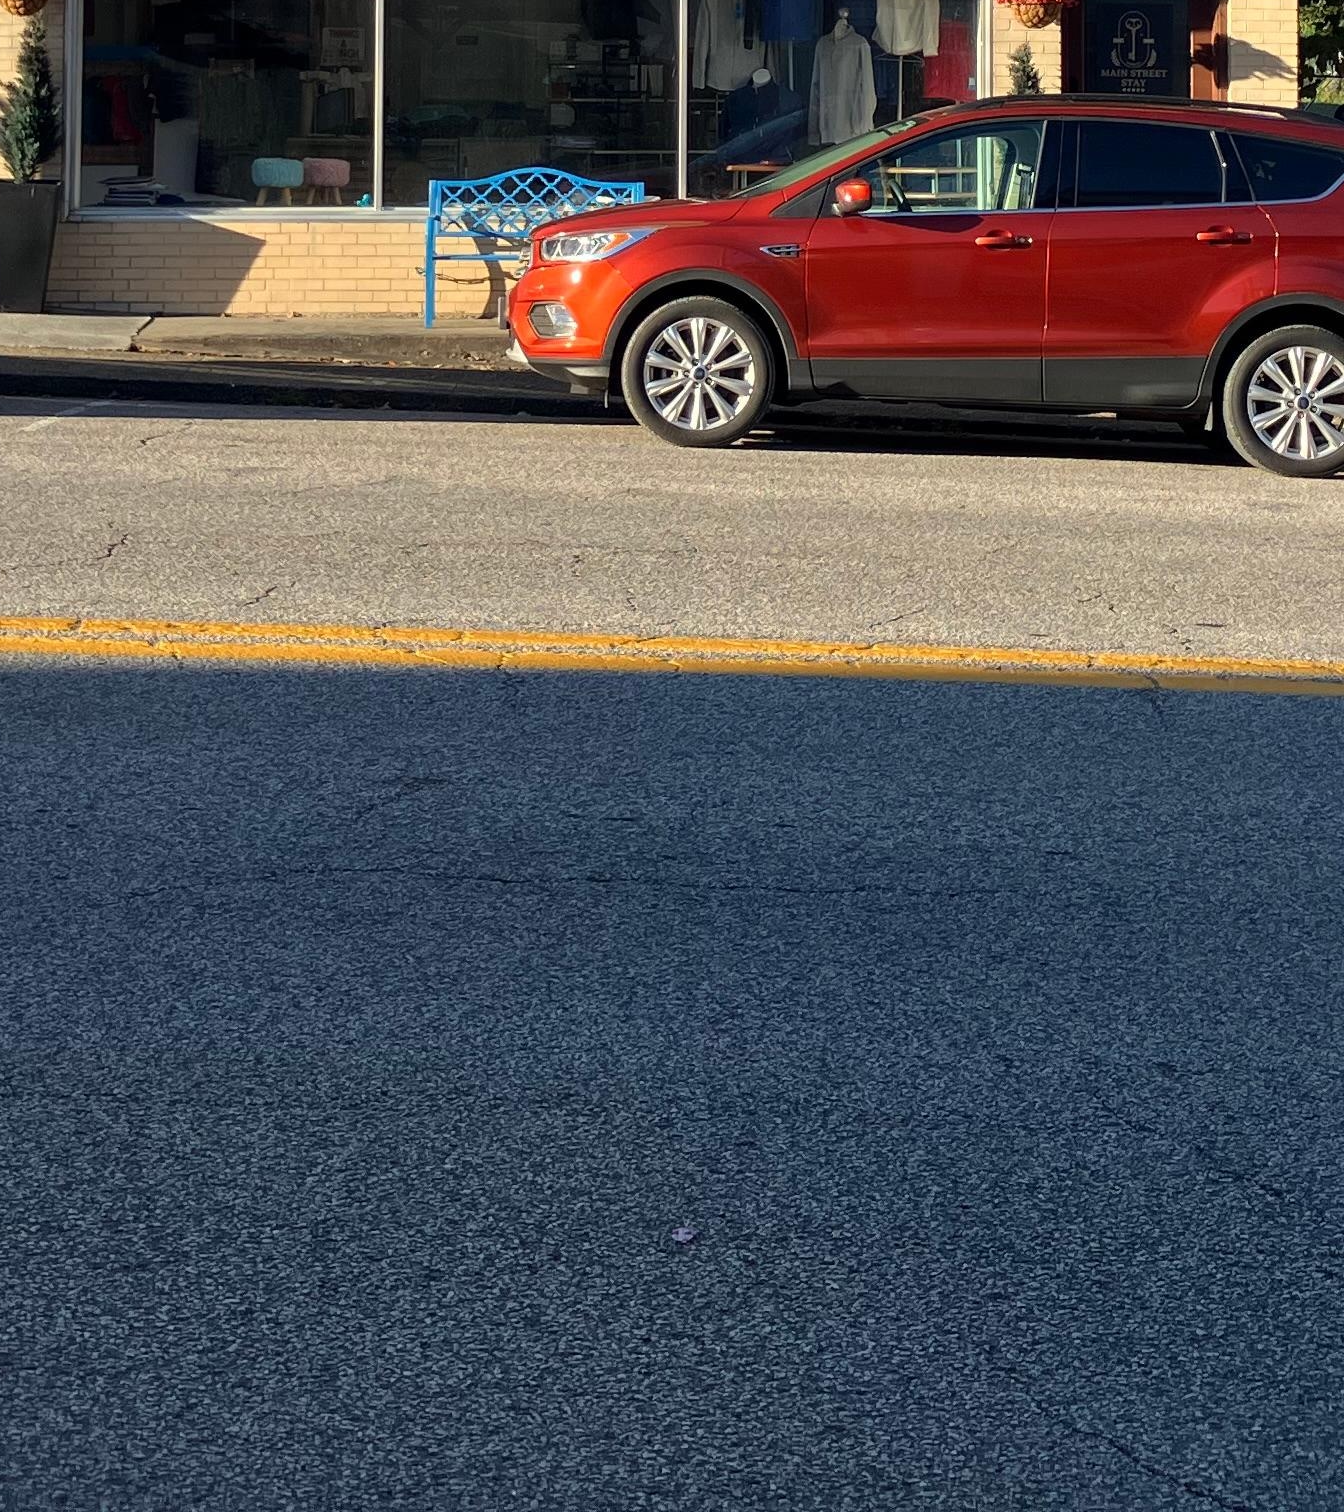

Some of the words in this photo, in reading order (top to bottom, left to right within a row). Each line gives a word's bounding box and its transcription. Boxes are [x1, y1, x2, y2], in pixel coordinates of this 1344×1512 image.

[1100, 68, 1128, 78] MAIN
[1130, 69, 1169, 78] STREET
[1120, 78, 1146, 87] STAY
